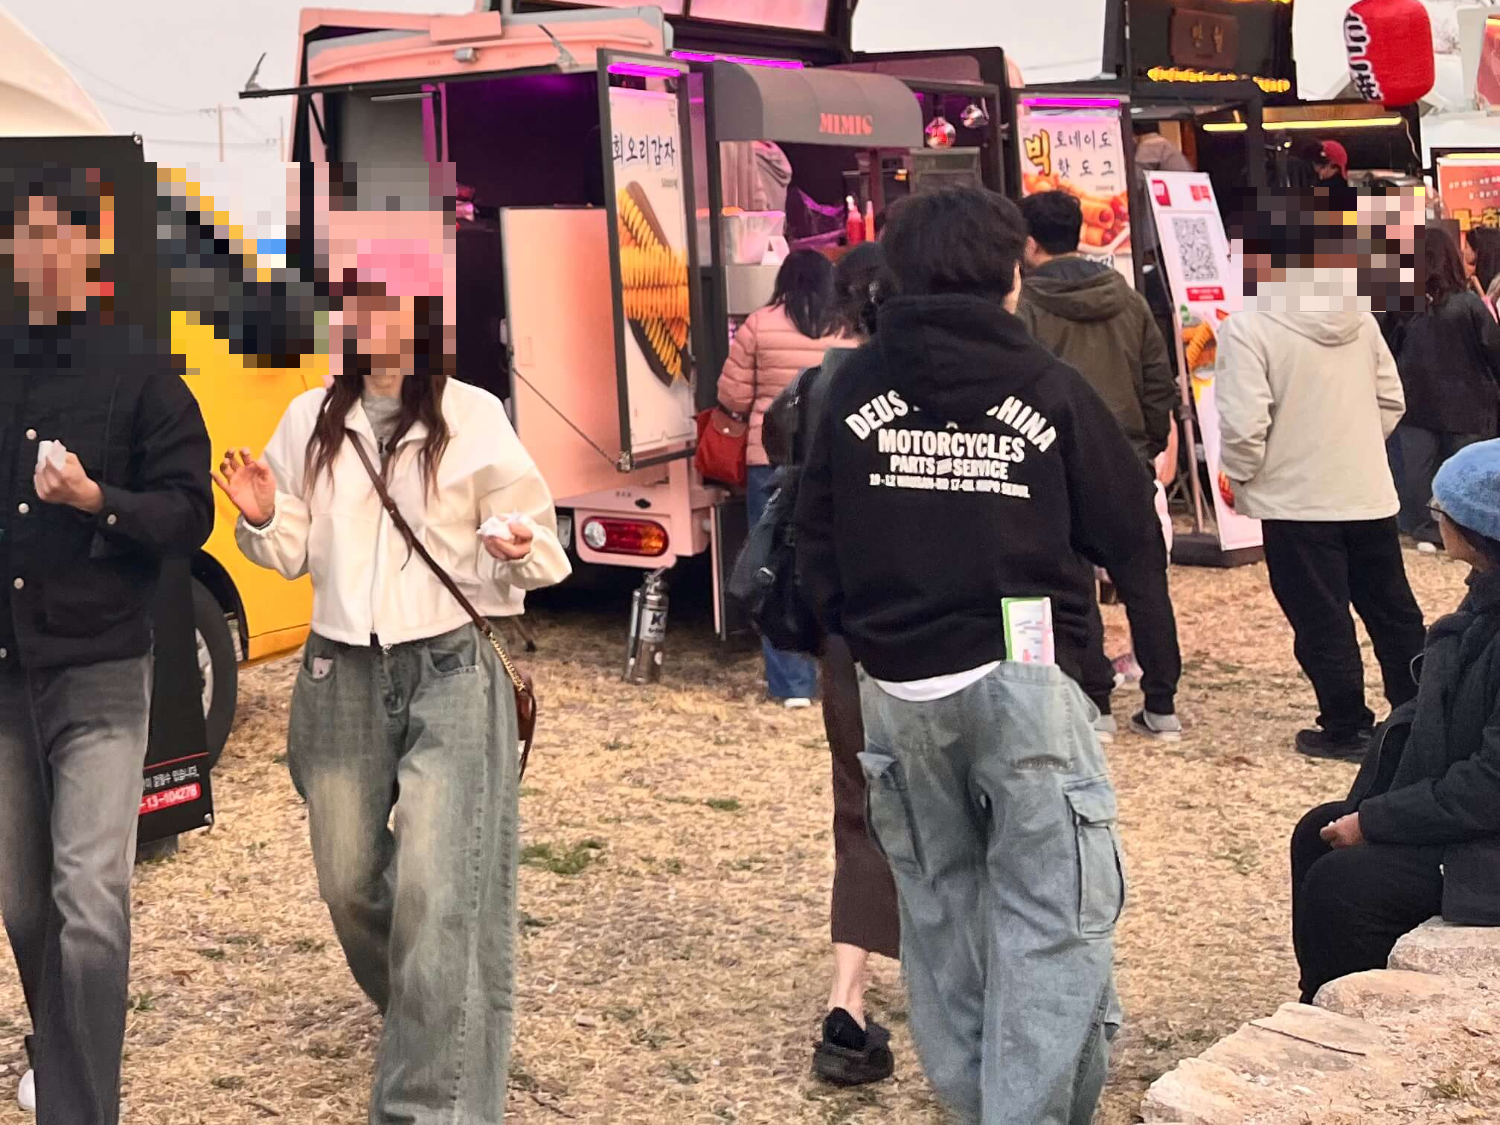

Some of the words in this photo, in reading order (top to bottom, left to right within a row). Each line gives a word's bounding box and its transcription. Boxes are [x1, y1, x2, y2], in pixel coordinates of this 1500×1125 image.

[819, 112, 873, 136] MIMIC
[612, 133, 676, 168] 회오리감자
[1023, 128, 1051, 177] 빅
[844, 389, 909, 440] DEUS
[985, 395, 1057, 453] HINA
[877, 427, 1026, 463] MOTORCYCLES
[890, 454, 936, 476] PARTS
[952, 457, 1010, 481] SERVICE
